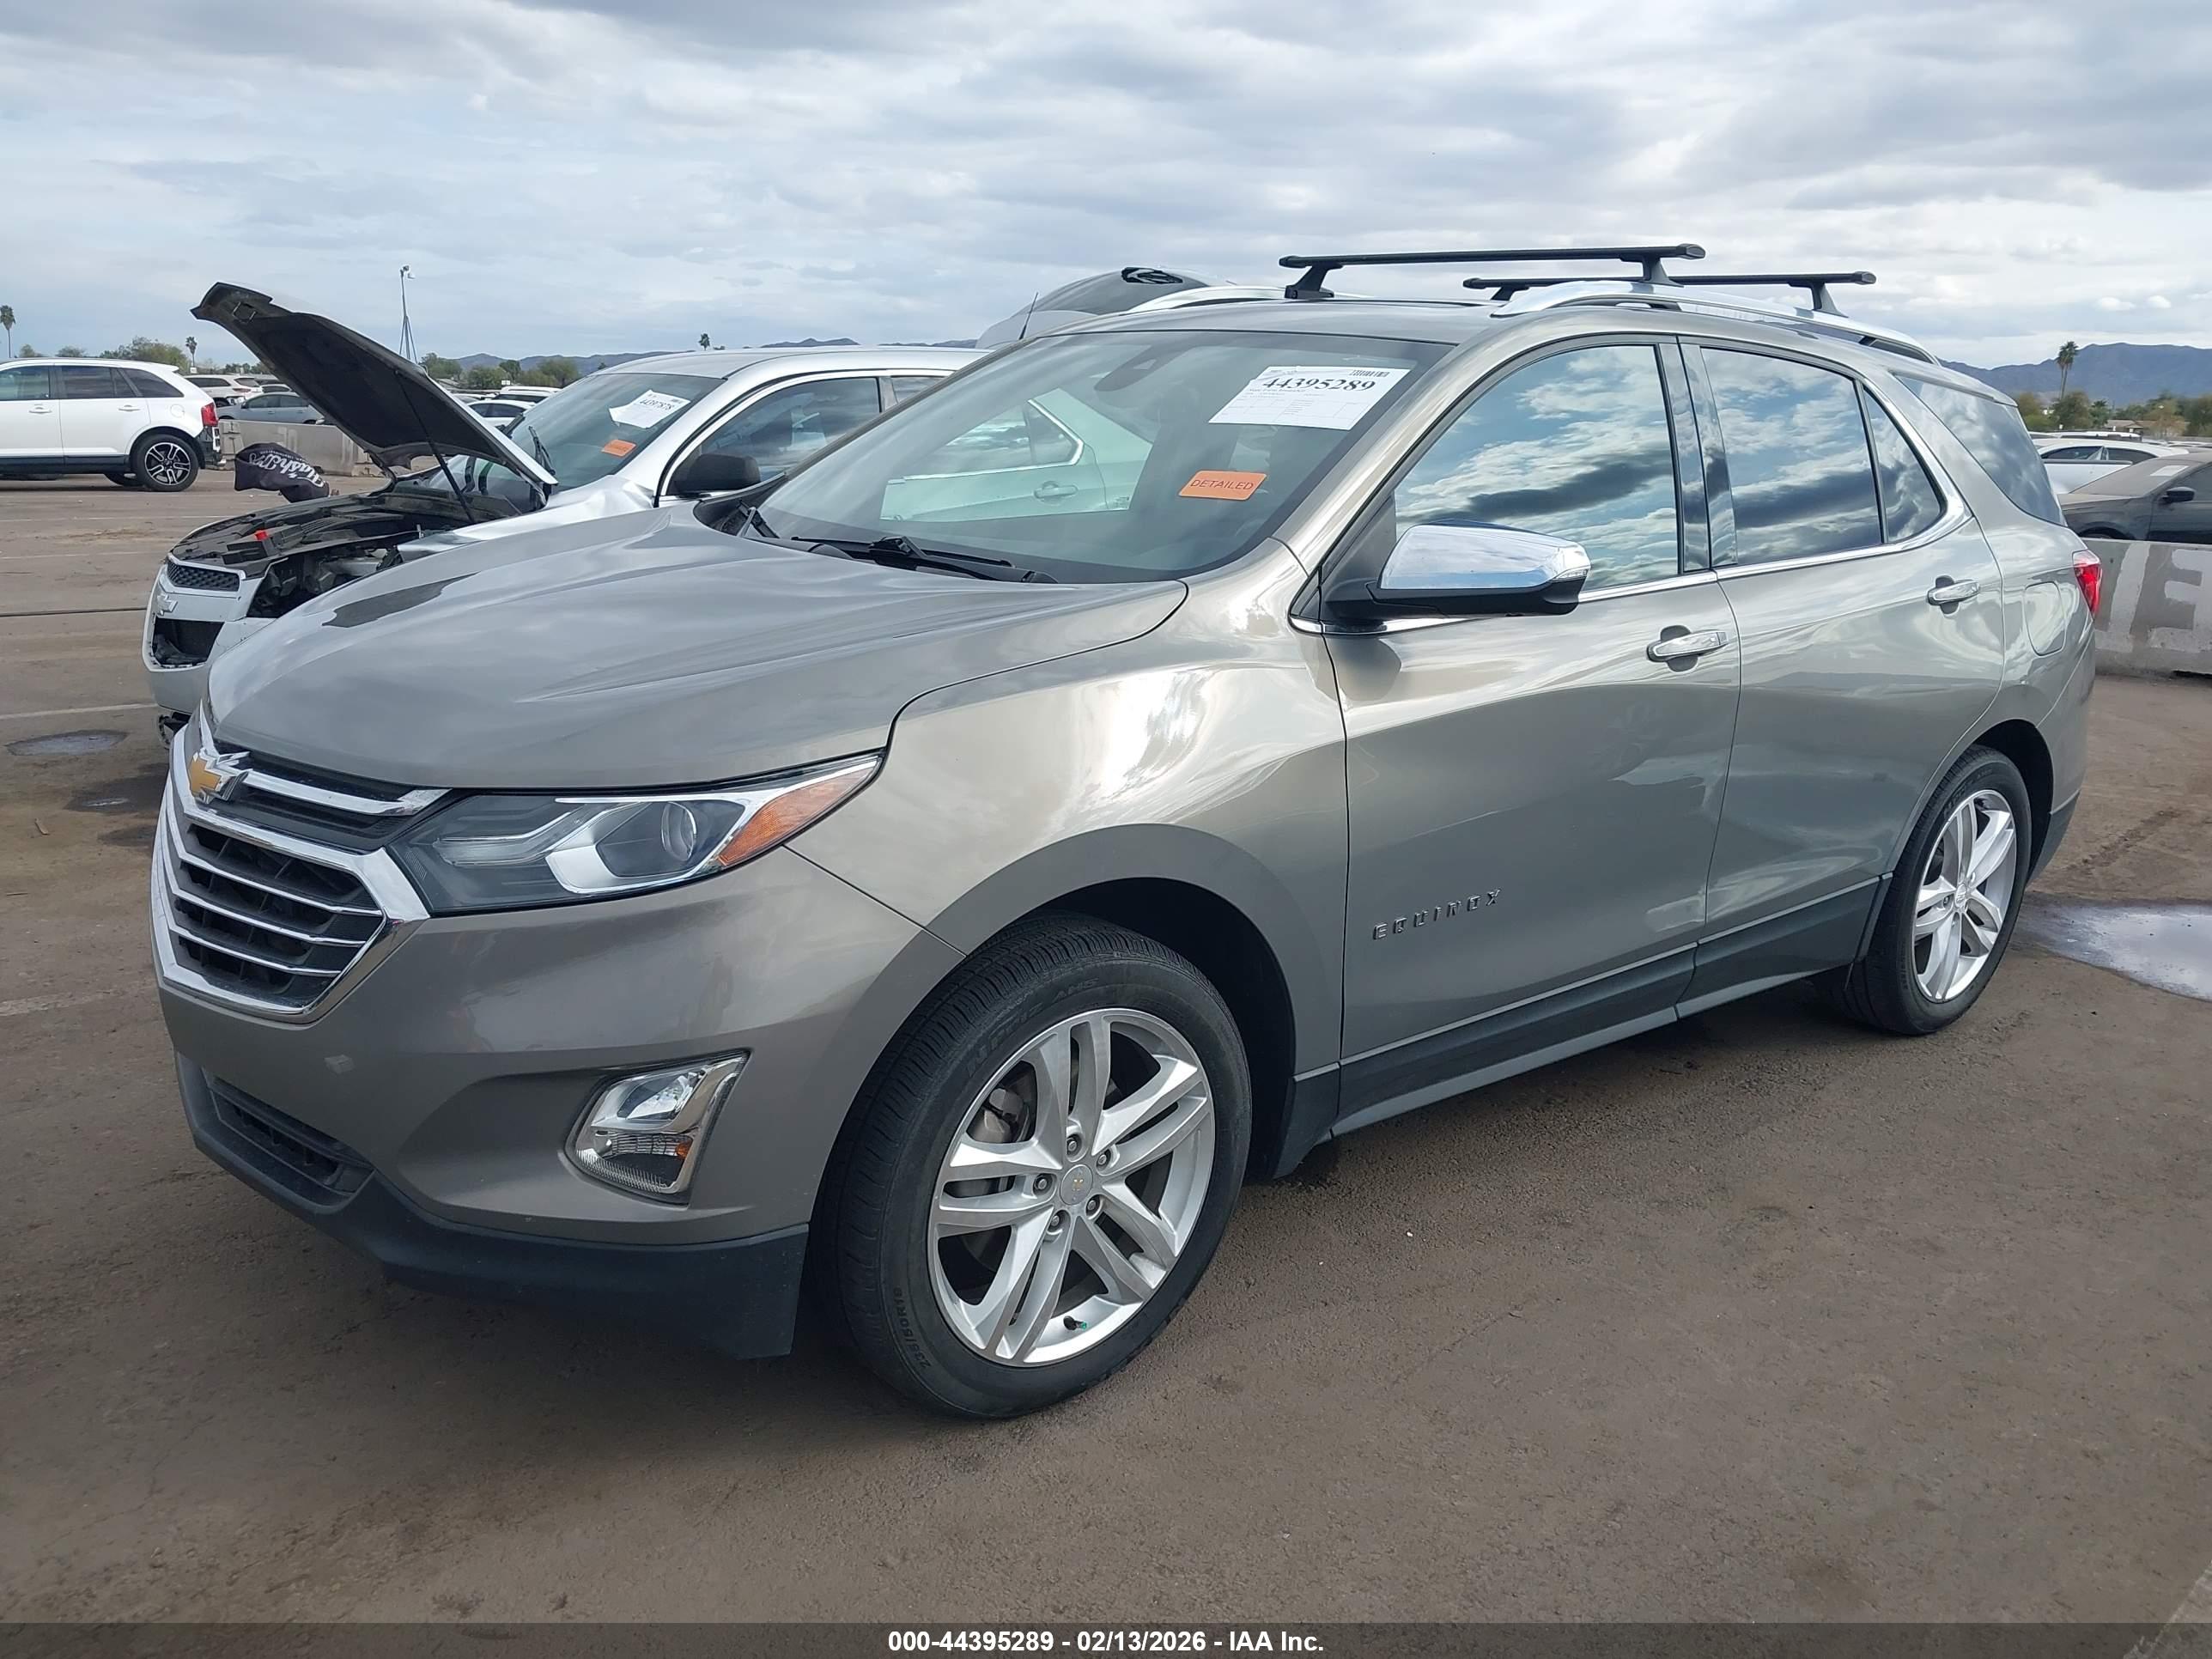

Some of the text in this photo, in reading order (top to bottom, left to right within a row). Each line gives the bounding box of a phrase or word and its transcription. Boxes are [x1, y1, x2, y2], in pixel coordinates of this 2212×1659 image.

[1262, 377, 1376, 392] 44395289
[1190, 479, 1254, 490] DETAILED
[1373, 887, 1501, 939] EQUINOX
